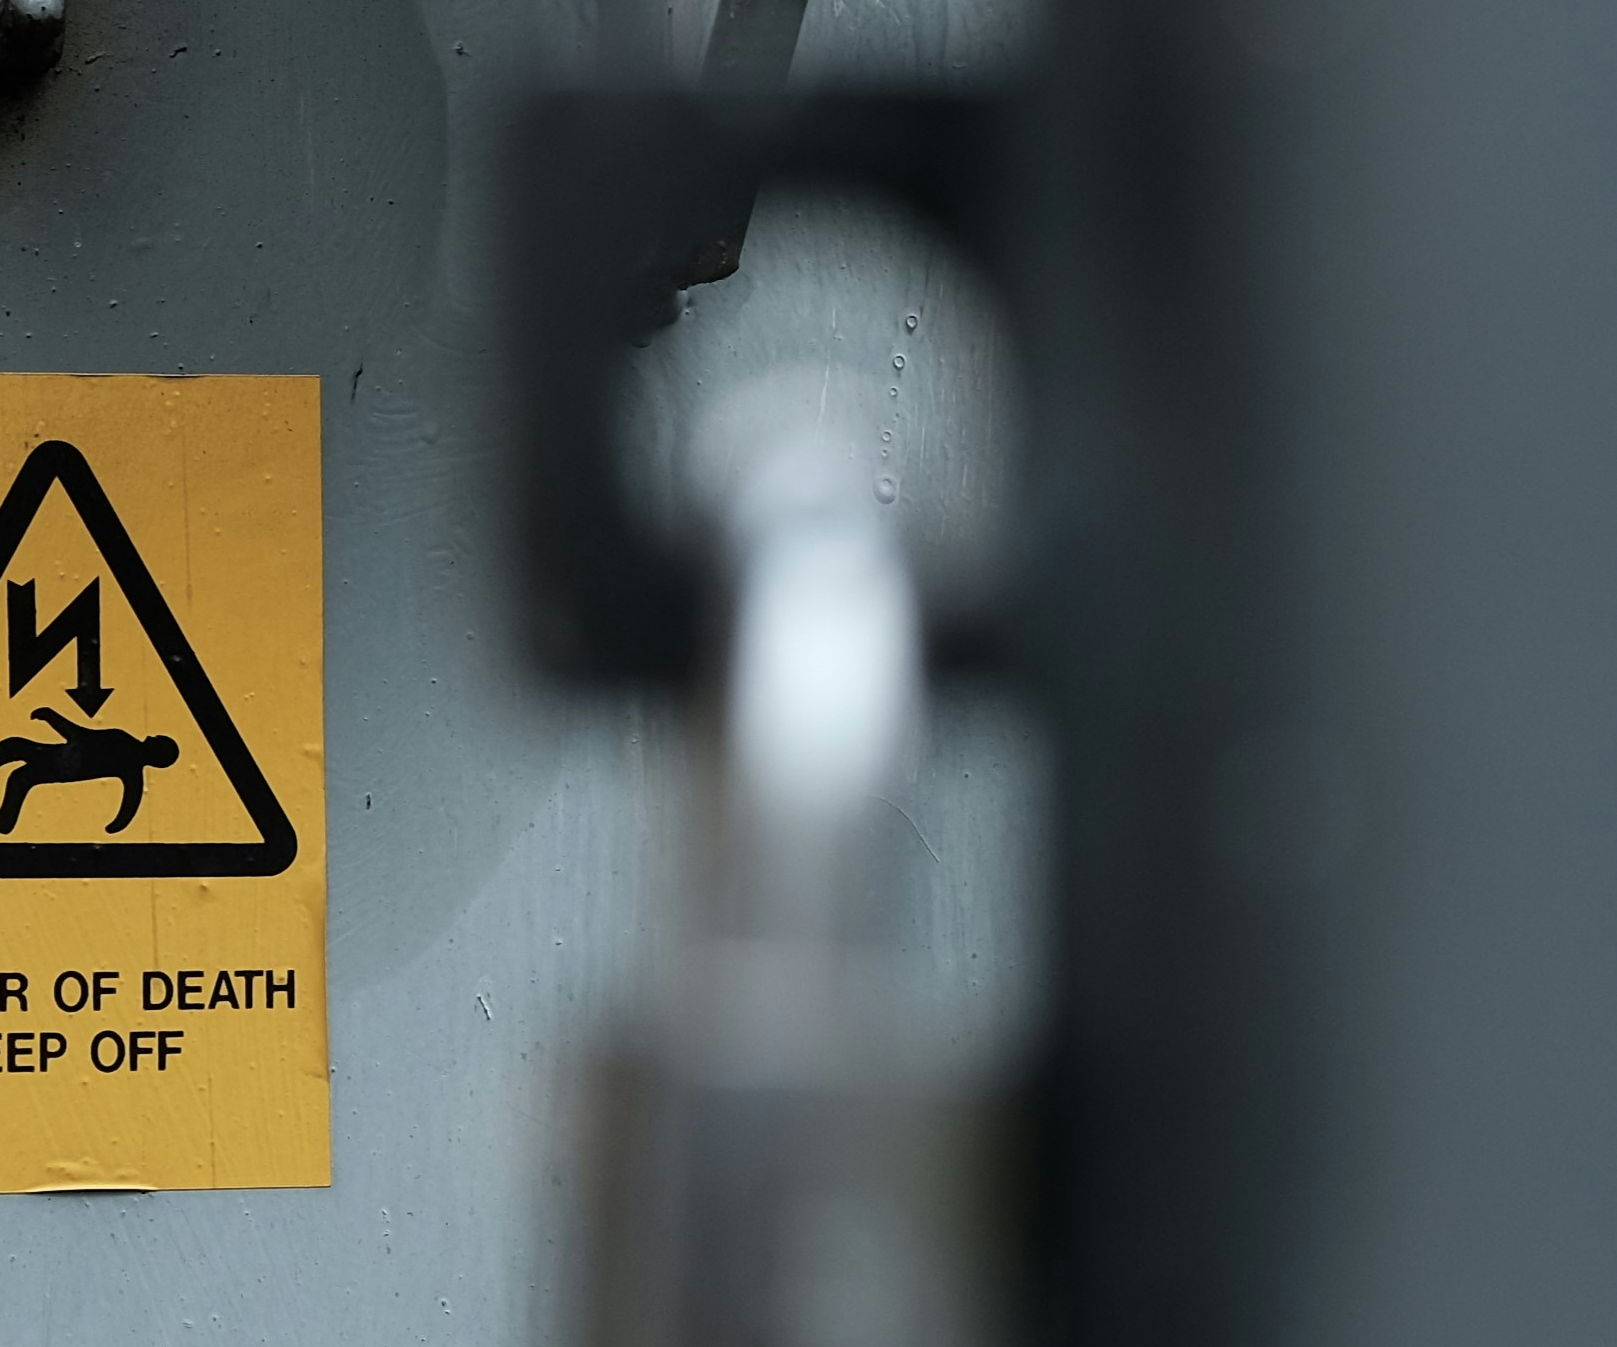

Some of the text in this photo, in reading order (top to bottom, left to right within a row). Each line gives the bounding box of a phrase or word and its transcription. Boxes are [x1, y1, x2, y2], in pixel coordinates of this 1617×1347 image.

[53, 970, 119, 1013] OF
[143, 970, 297, 1012] DEATH
[90, 1030, 185, 1074] OFF
